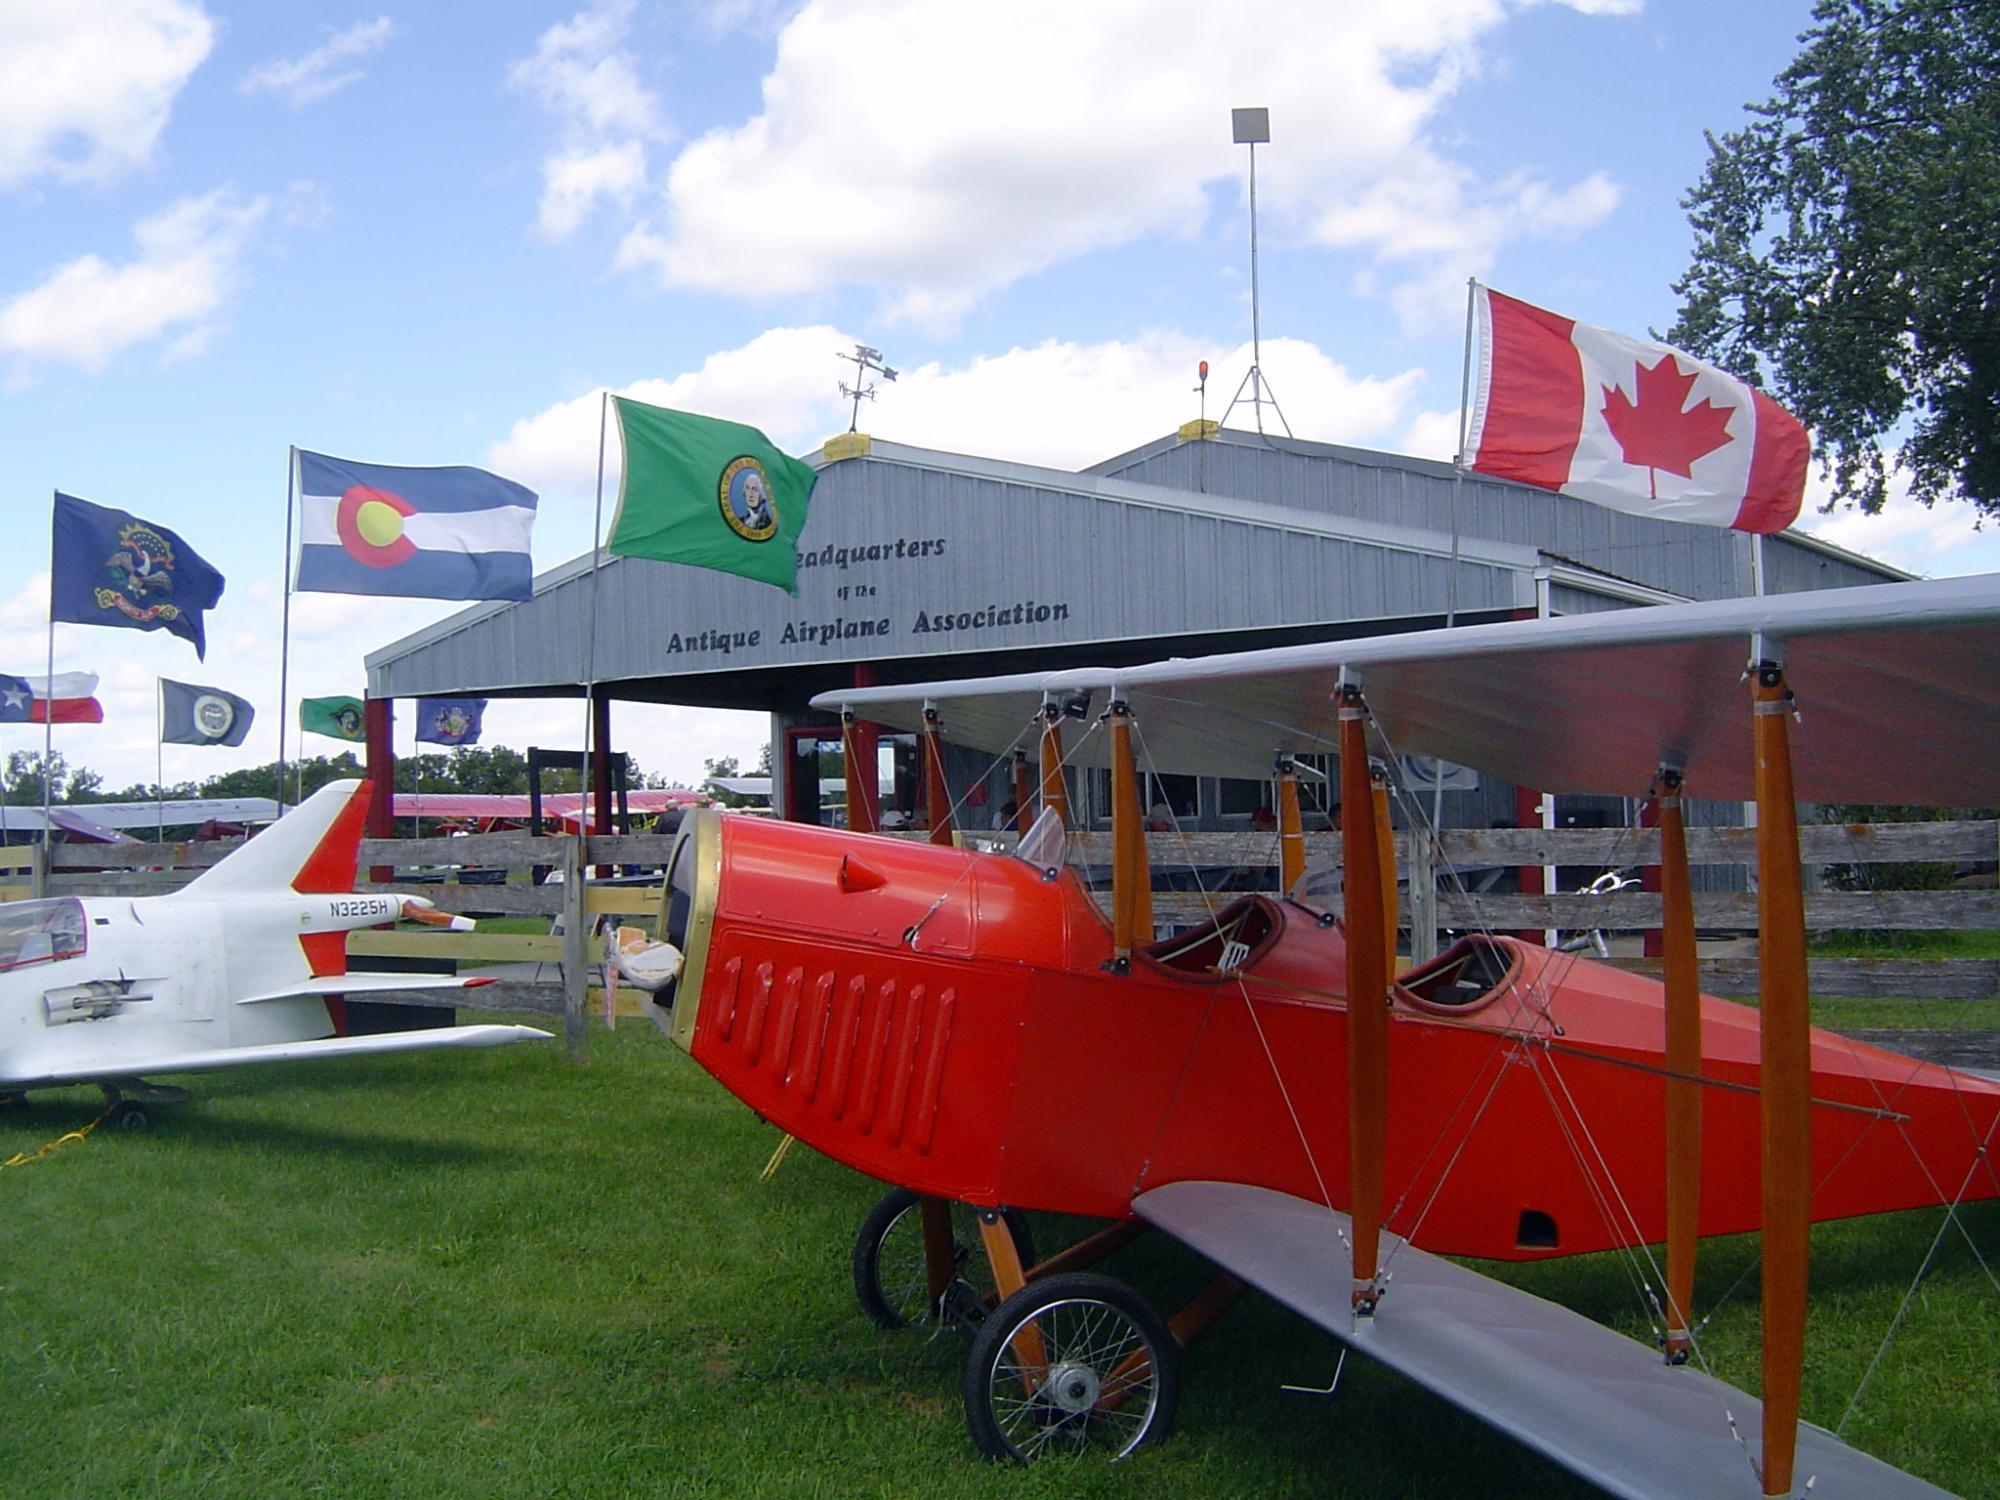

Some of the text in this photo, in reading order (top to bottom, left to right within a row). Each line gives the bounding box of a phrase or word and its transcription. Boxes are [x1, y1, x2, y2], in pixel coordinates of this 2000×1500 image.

[797, 538, 946, 569] eadquarters
[837, 585, 877, 600] of the
[666, 601, 1069, 654] Antique Airplane Association
[329, 900, 388, 917] N3225H
